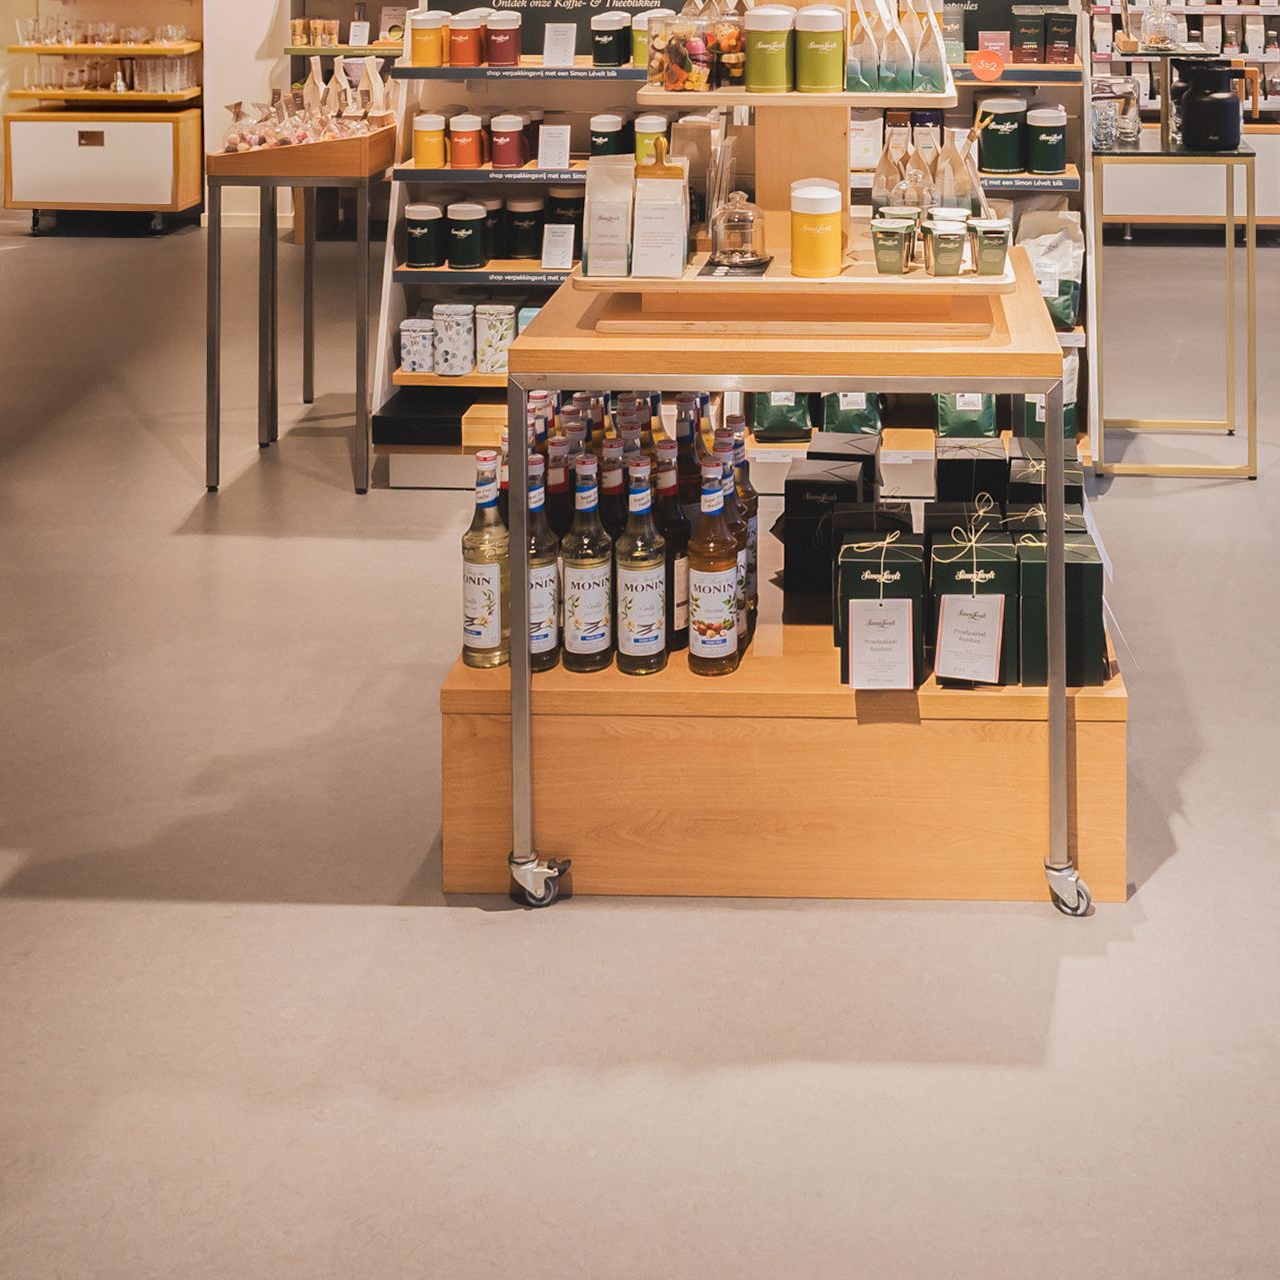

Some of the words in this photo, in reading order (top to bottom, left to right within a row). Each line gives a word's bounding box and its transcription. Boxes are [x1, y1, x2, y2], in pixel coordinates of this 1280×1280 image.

[464, 575, 491, 586] ONIN
[529, 577, 555, 590] ONIN
[624, 580, 664, 593] MONIN
[693, 581, 734, 594] MONIN
